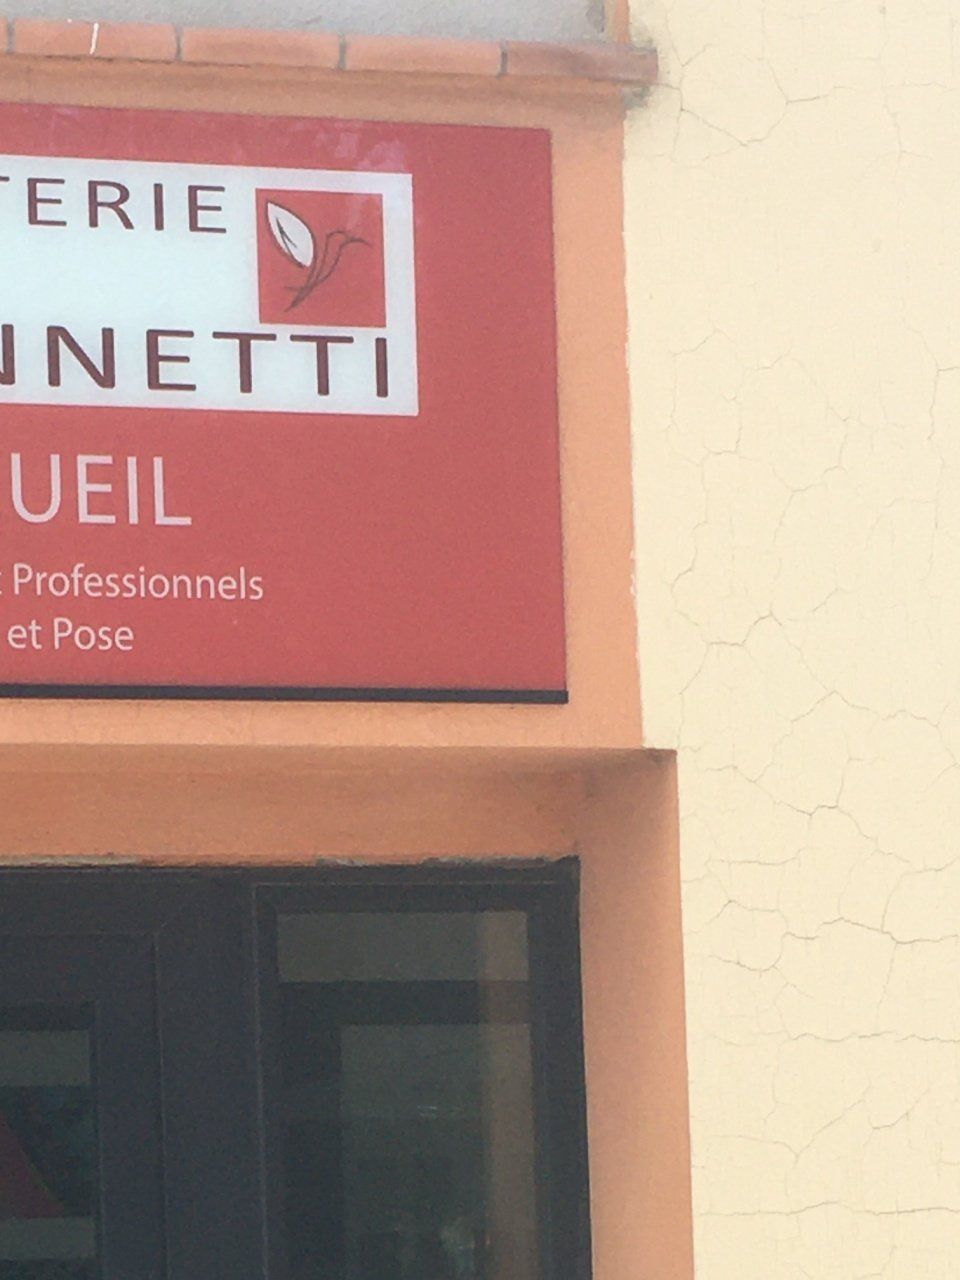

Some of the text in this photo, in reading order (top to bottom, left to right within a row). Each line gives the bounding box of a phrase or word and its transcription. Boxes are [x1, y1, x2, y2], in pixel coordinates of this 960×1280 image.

[13, 562, 264, 601] Professionnels
[7, 619, 42, 650] et
[54, 617, 134, 651] Pose
